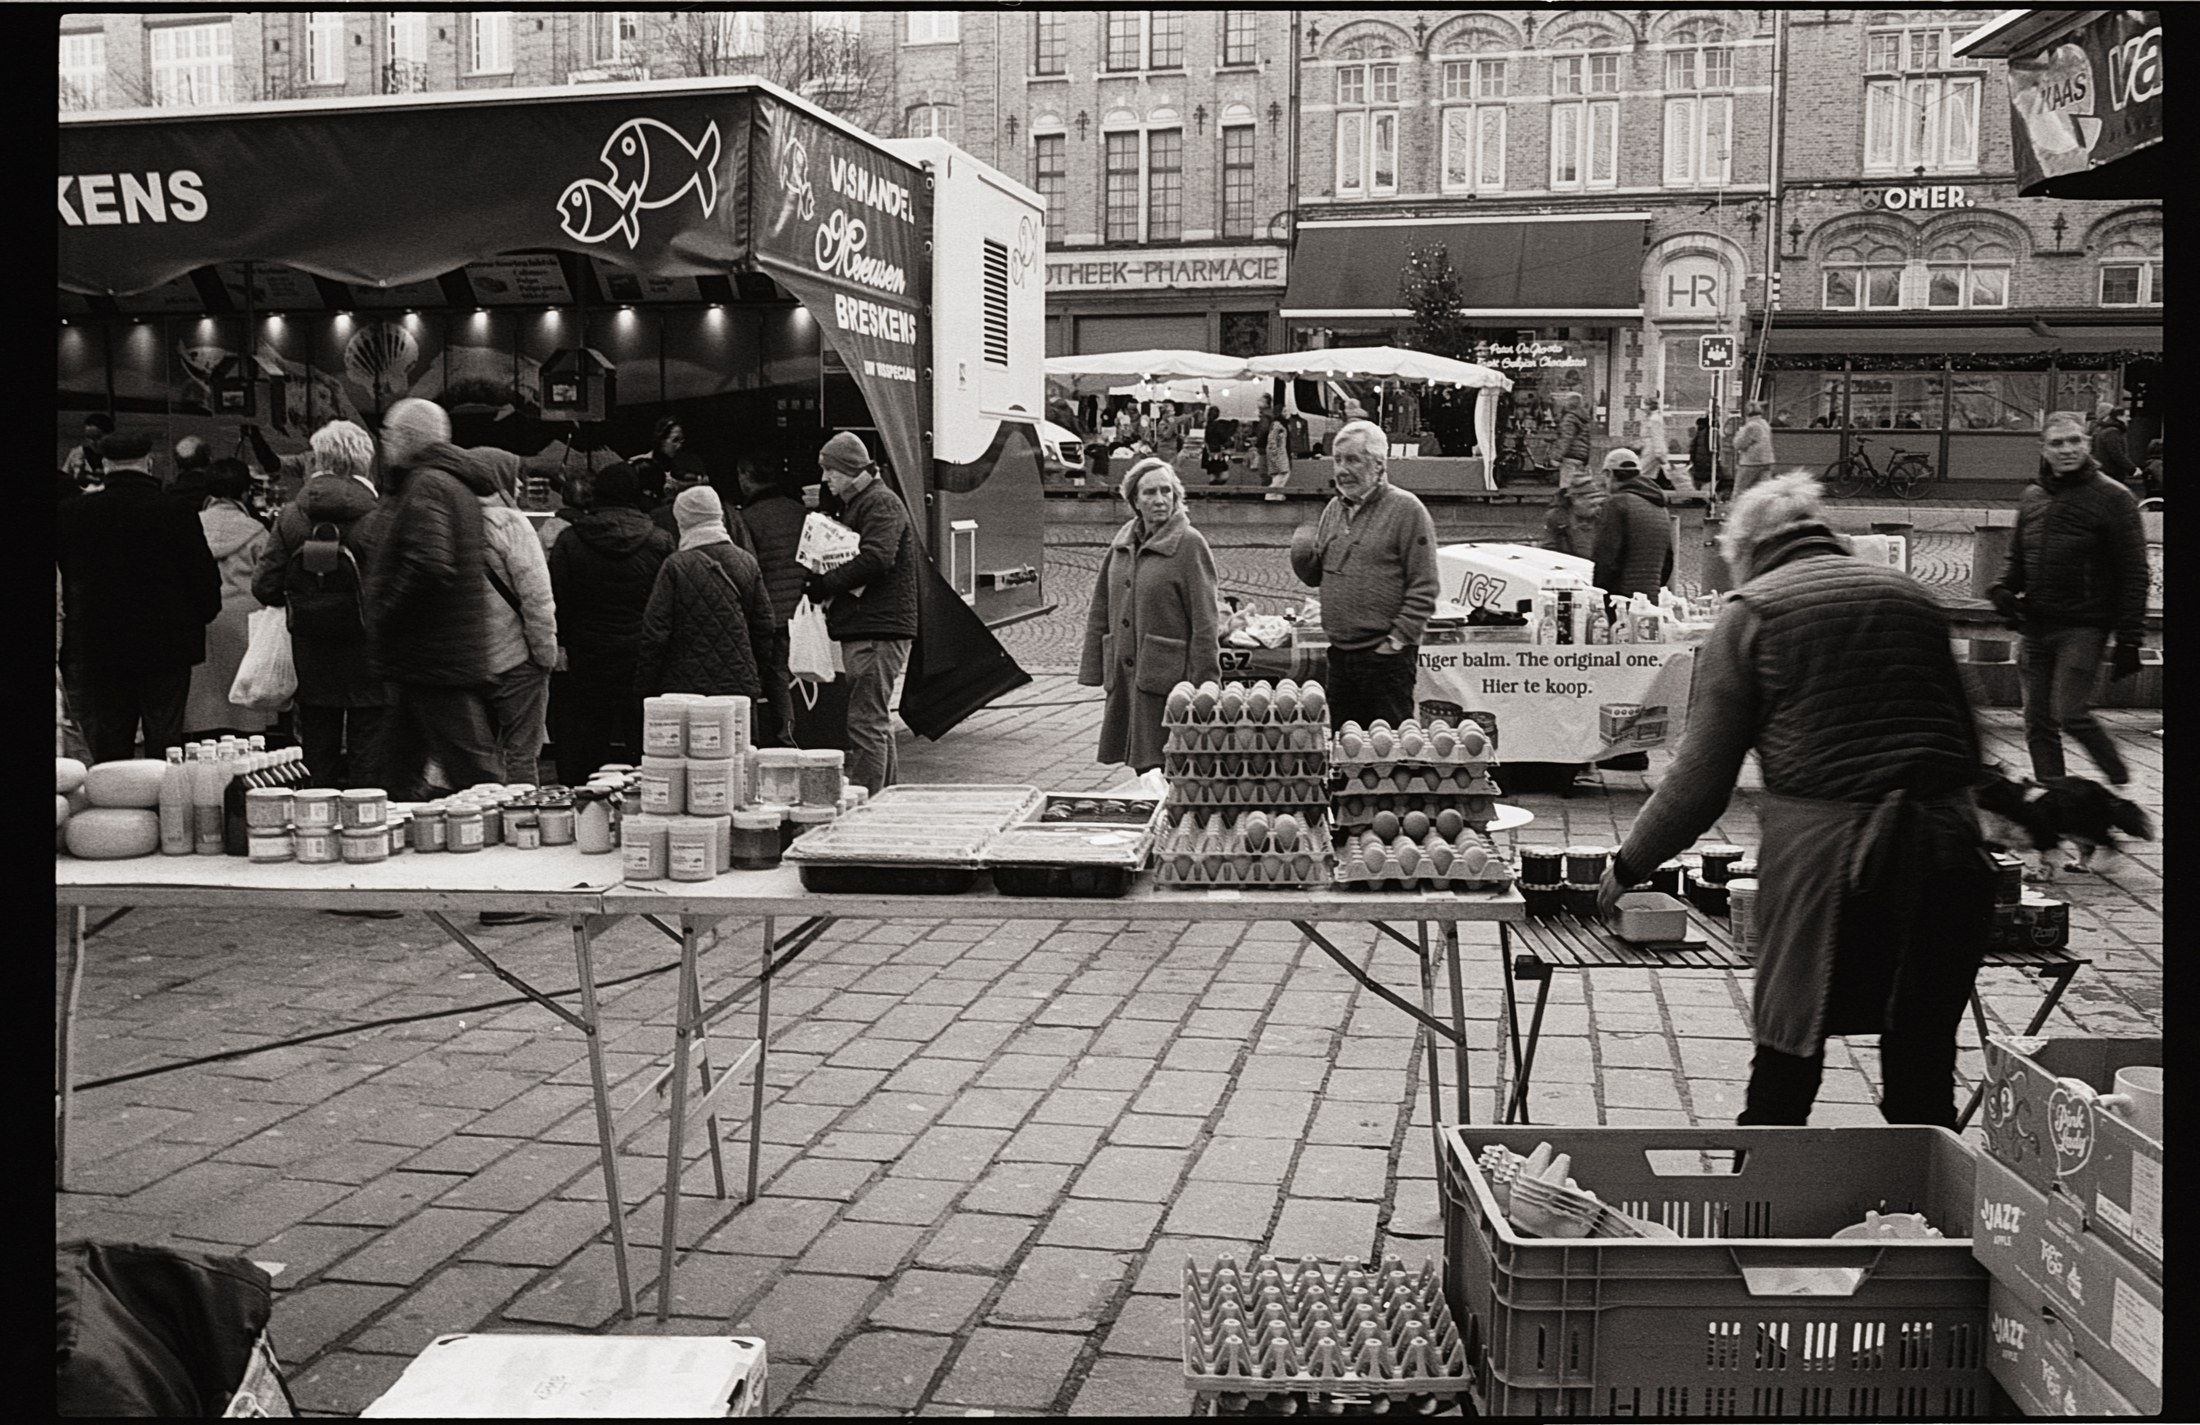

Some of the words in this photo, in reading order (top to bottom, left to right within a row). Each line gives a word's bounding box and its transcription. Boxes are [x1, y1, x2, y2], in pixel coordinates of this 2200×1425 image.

[2039, 72, 2087, 114] KAAS
[58, 169, 208, 226] KENS
[830, 154, 914, 225] VISHANDEL
[1884, 185, 1975, 209] OMER.
[815, 208, 906, 295] Meeusen
[1668, 274, 1717, 307] HR
[835, 293, 916, 345] BRESKENS
[1462, 652, 1511, 667] balm.
[1516, 652, 1549, 667] The
[1554, 651, 1620, 671] original
[1626, 655, 1663, 667] one.
[1482, 679, 1519, 693] Hier
[1524, 679, 1541, 693] te
[1545, 678, 1593, 698] koop.
[2054, 1104, 2085, 1132] Pink
[2056, 1127, 2090, 1158] Lady
[1981, 1198, 2020, 1233] JAZZ
[1991, 1312, 2025, 1350] JAZZ
